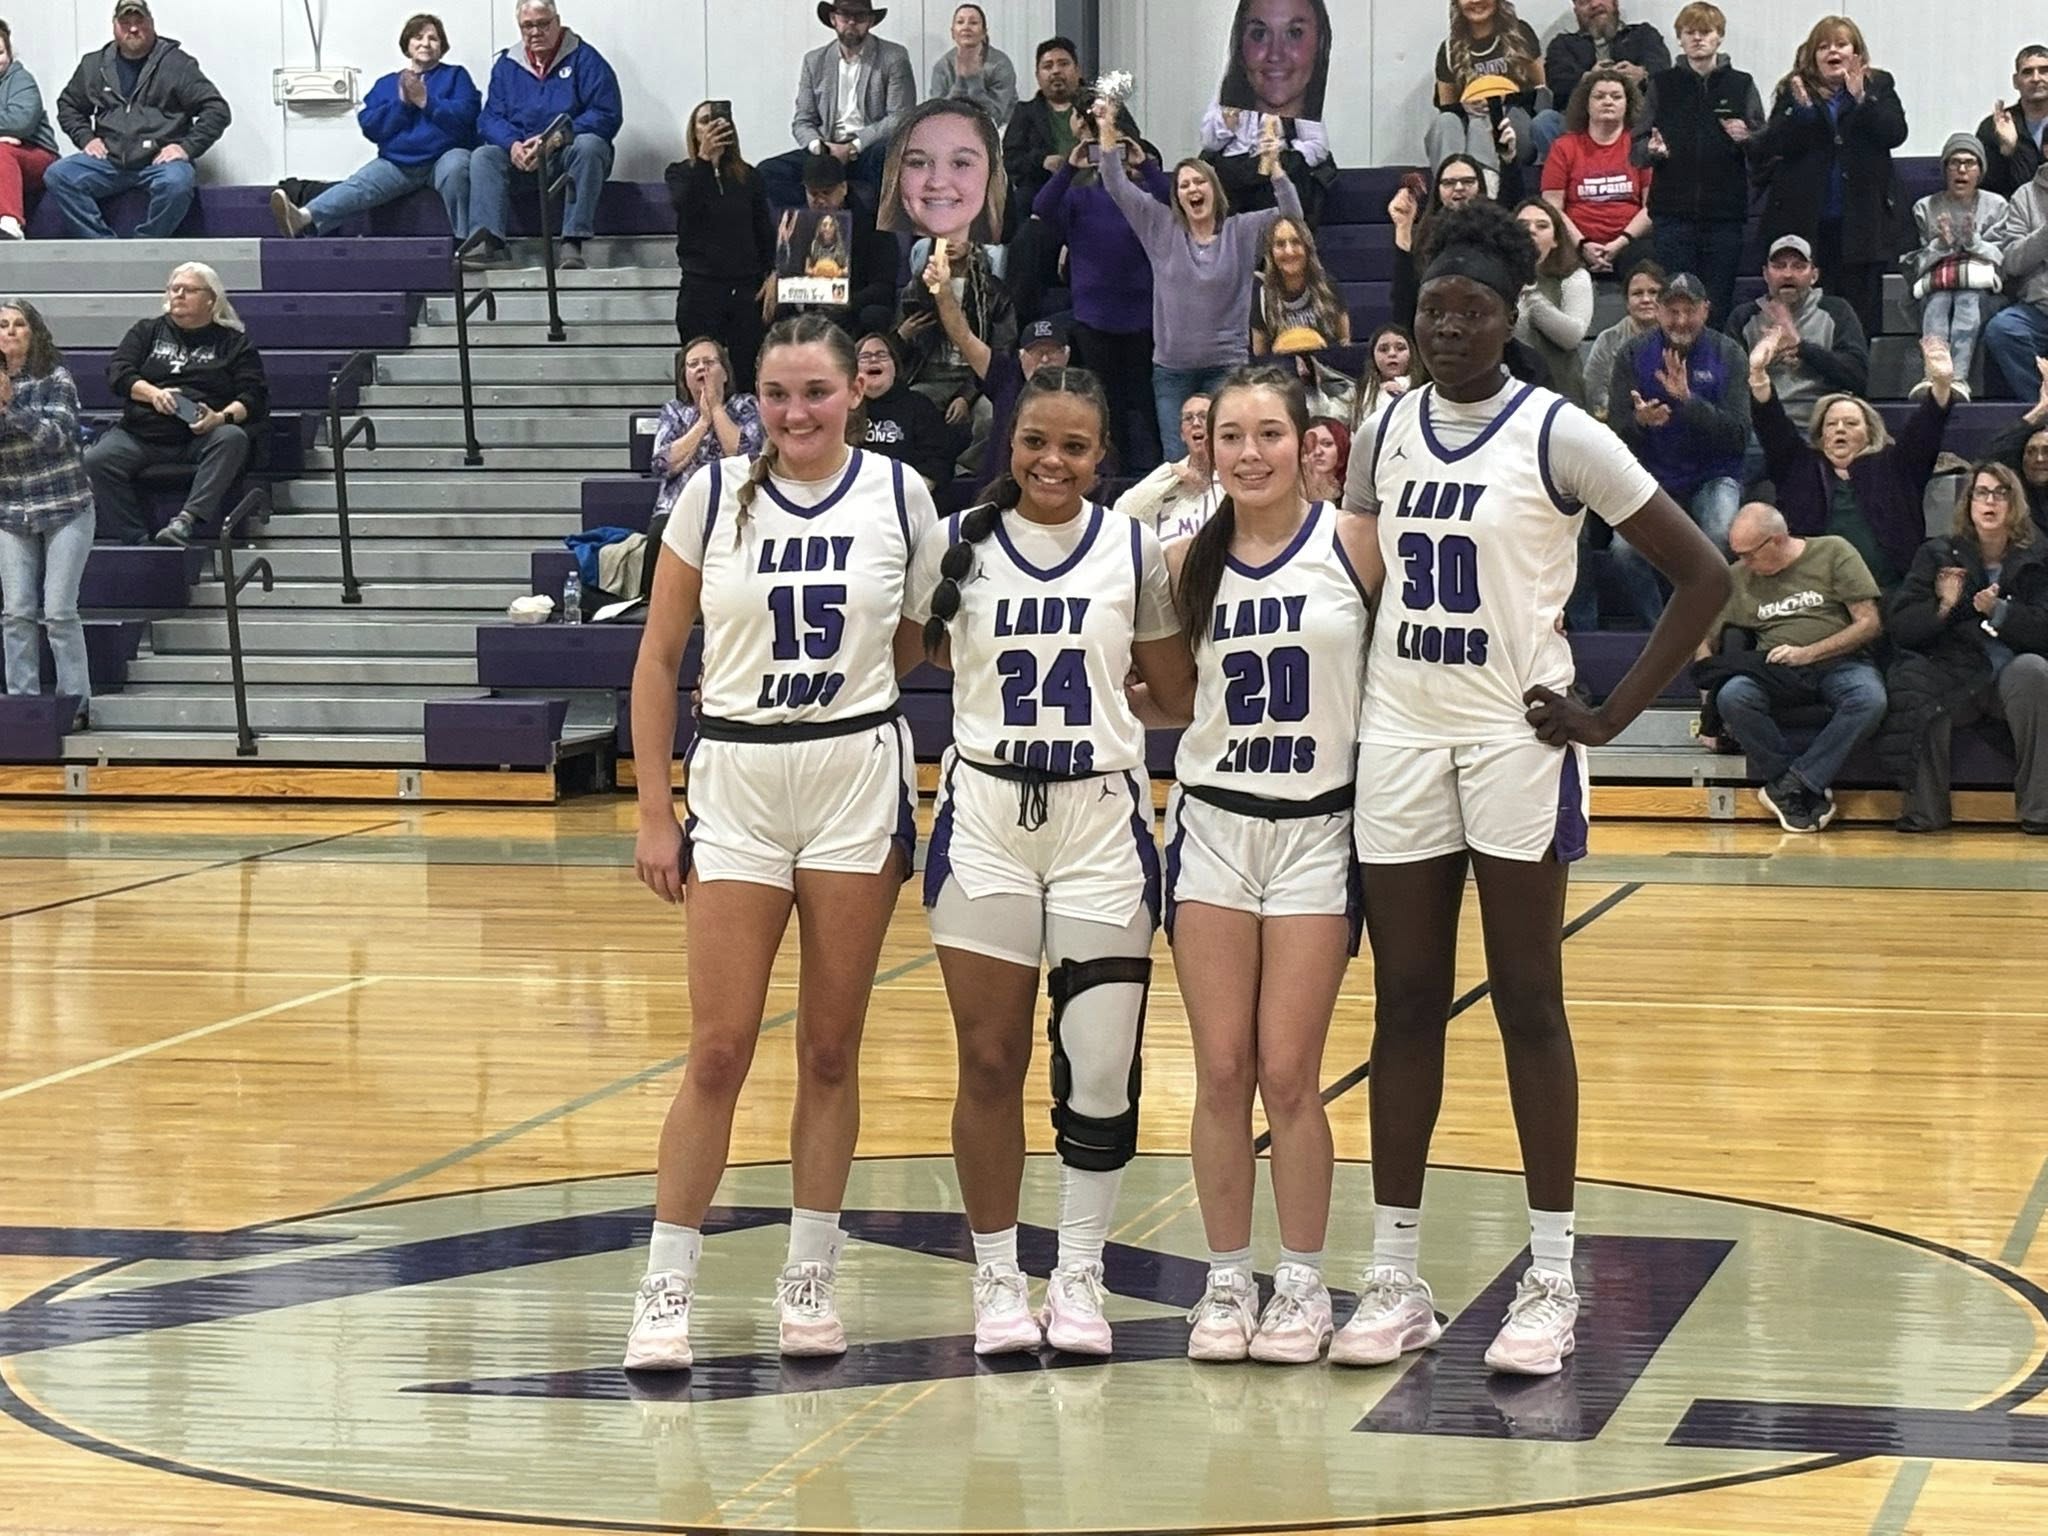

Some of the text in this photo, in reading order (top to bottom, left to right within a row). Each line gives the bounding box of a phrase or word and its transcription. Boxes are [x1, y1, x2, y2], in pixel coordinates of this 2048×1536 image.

[864, 430, 897, 443] ONS
[1396, 480, 1488, 521] LADY
[757, 536, 855, 574] LADY
[1398, 532, 1481, 614] 30
[768, 584, 847, 660] 15
[994, 597, 1091, 637] LADY
[1212, 595, 1308, 642] LADY
[1397, 621, 1489, 667] LIONS
[757, 671, 845, 709] LIONS
[996, 649, 1092, 726] 24
[1222, 646, 1309, 726] 20
[1216, 736, 1316, 774] LIONS
